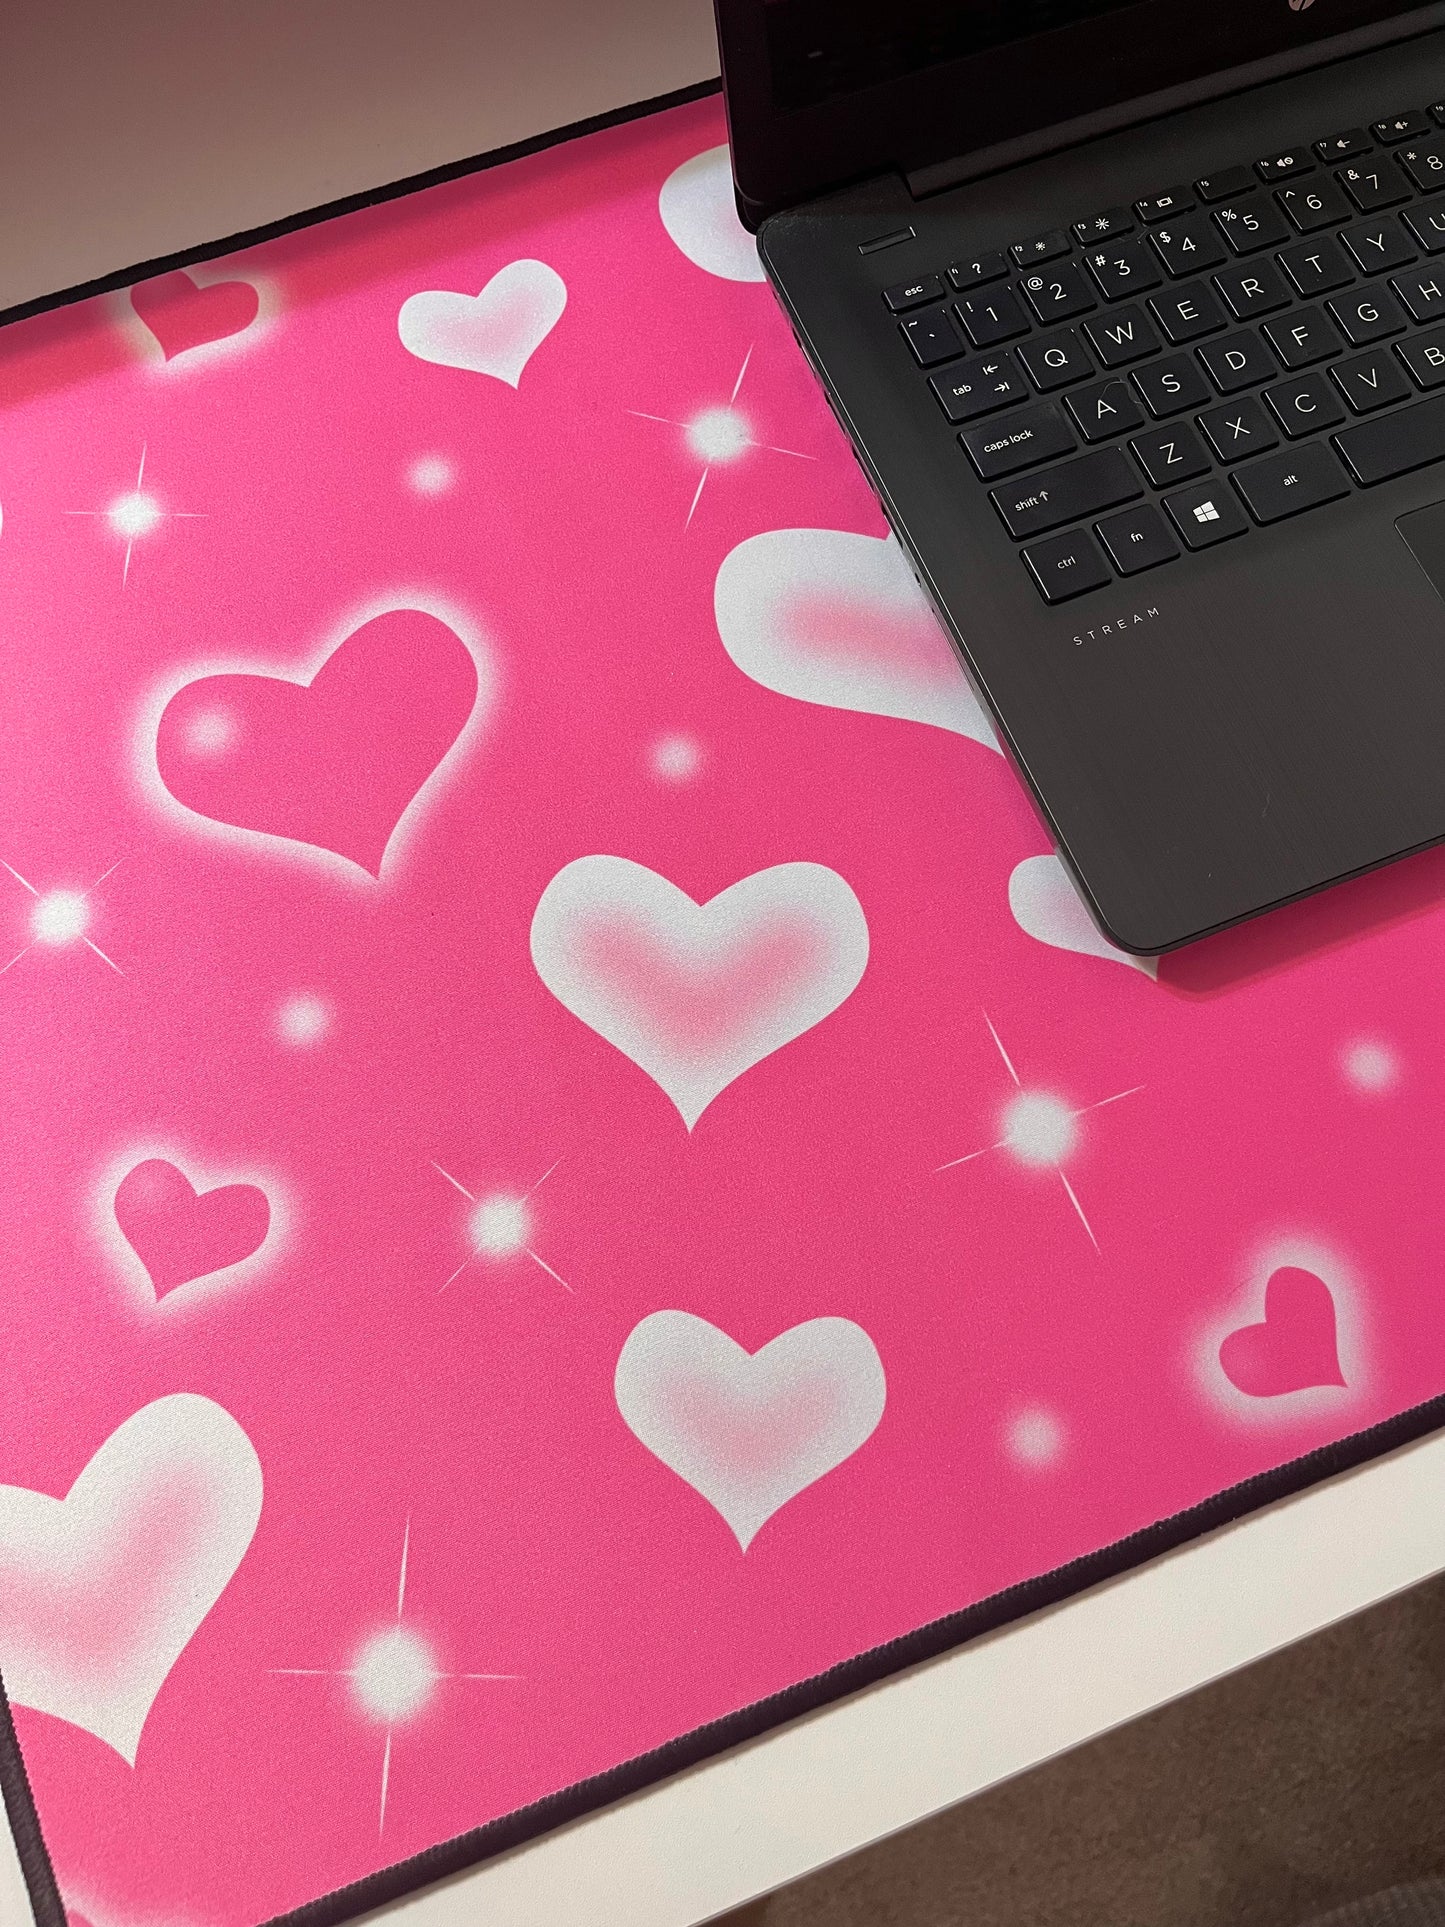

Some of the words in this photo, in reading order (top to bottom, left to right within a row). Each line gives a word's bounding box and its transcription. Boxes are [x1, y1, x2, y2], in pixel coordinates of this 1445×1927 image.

[1426, 155, 1443, 170] 8
[1347, 169, 1360, 180] &
[1365, 174, 1378, 190] 7
[1306, 194, 1322, 210] 6
[1221, 208, 1237, 222] %
[1242, 214, 1259, 231] 5
[1429, 213, 1445, 231] U
[1159, 231, 1172, 244] $
[1182, 236, 1196, 251] 4
[1366, 233, 1385, 252] Y
[971, 263, 981, 274] ?
[1095, 254, 1106, 267] #
[1113, 259, 1131, 276] 3
[1304, 255, 1323, 273] T
[904, 285, 924, 297] esc
[1027, 276, 1044, 291] @
[1049, 283, 1067, 300] 2
[1240, 278, 1265, 298] R
[1418, 280, 1442, 301] H
[966, 301, 974, 313] !
[986, 306, 998, 322] 1
[1176, 300, 1199, 321] E
[1357, 303, 1379, 322] G
[1105, 321, 1133, 345] W
[1291, 325, 1309, 347] F
[1044, 349, 1068, 368] Q
[1224, 351, 1246, 370] D
[1423, 347, 1445, 366] B
[1161, 374, 1181, 393] S
[1357, 368, 1377, 388] V
[952, 384, 972, 396] tab
[1098, 399, 1117, 418] A
[1294, 394, 1317, 413] C
[1225, 416, 1251, 439] X
[983, 439, 1010, 453] caps
[1009, 429, 1034, 444] lock
[1159, 442, 1183, 464] Z
[1283, 475, 1298, 486] alt
[1015, 497, 1039, 511] shift
[1130, 533, 1144, 543] fn
[1057, 555, 1076, 569] ctrl
[1073, 607, 1159, 646] STREAM
